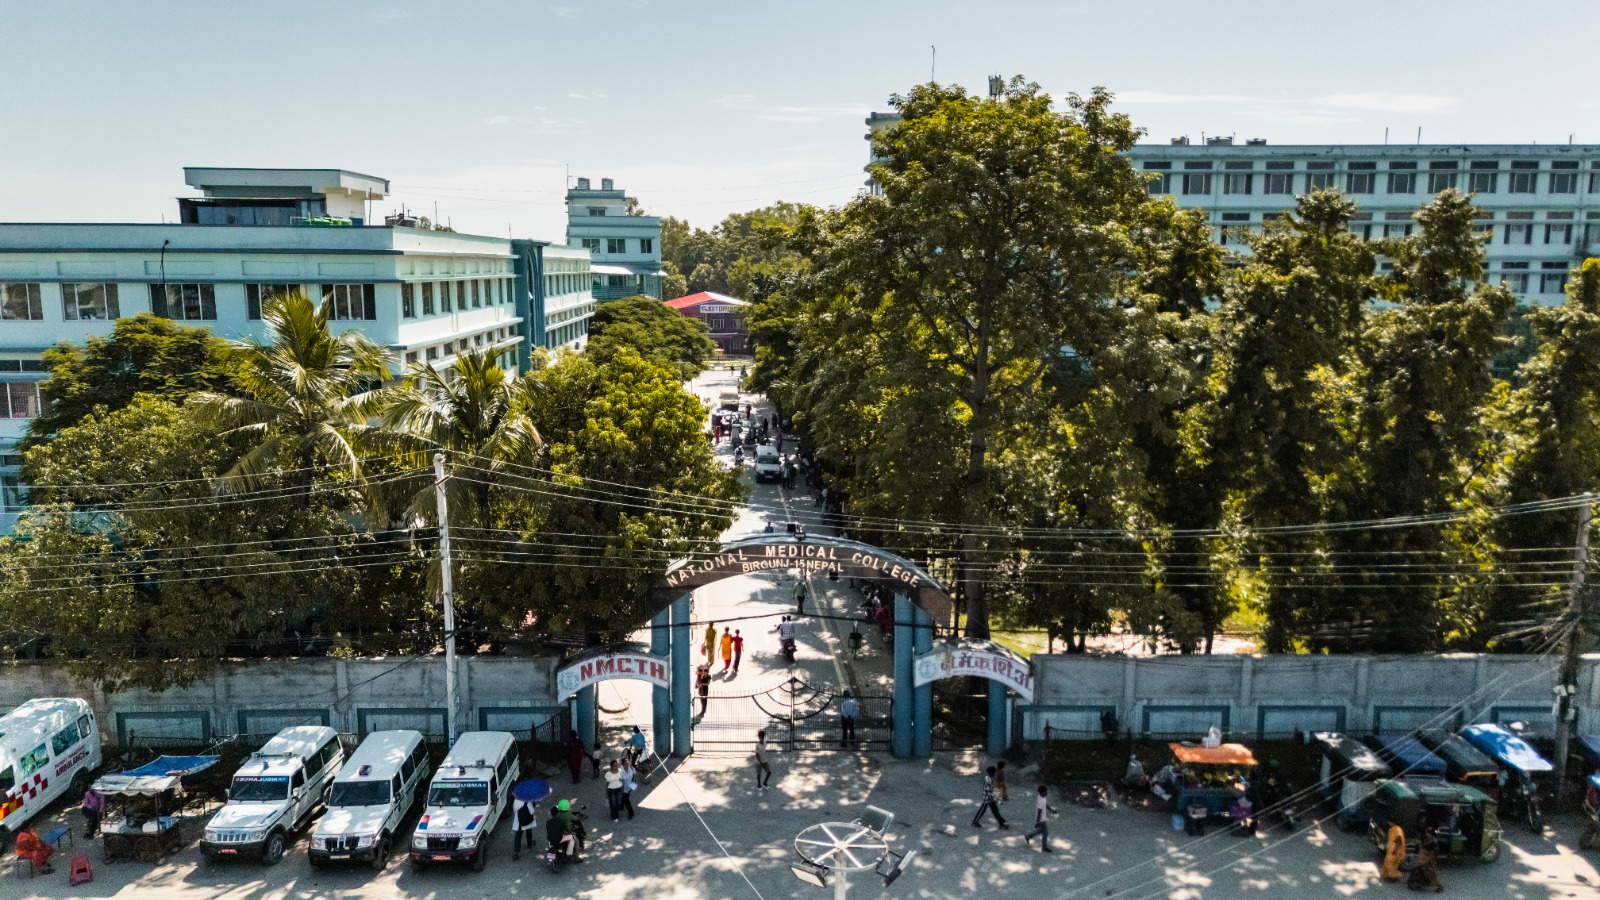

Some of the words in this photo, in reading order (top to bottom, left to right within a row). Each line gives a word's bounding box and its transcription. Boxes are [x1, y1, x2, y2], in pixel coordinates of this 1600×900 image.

[666, 549, 748, 587] NATIONAL
[765, 545, 837, 560] MEDICAL
[852, 552, 920, 588] COLLEGE
[807, 560, 844, 573] NEPAL
[56, 750, 86, 777] AMBULANCE
